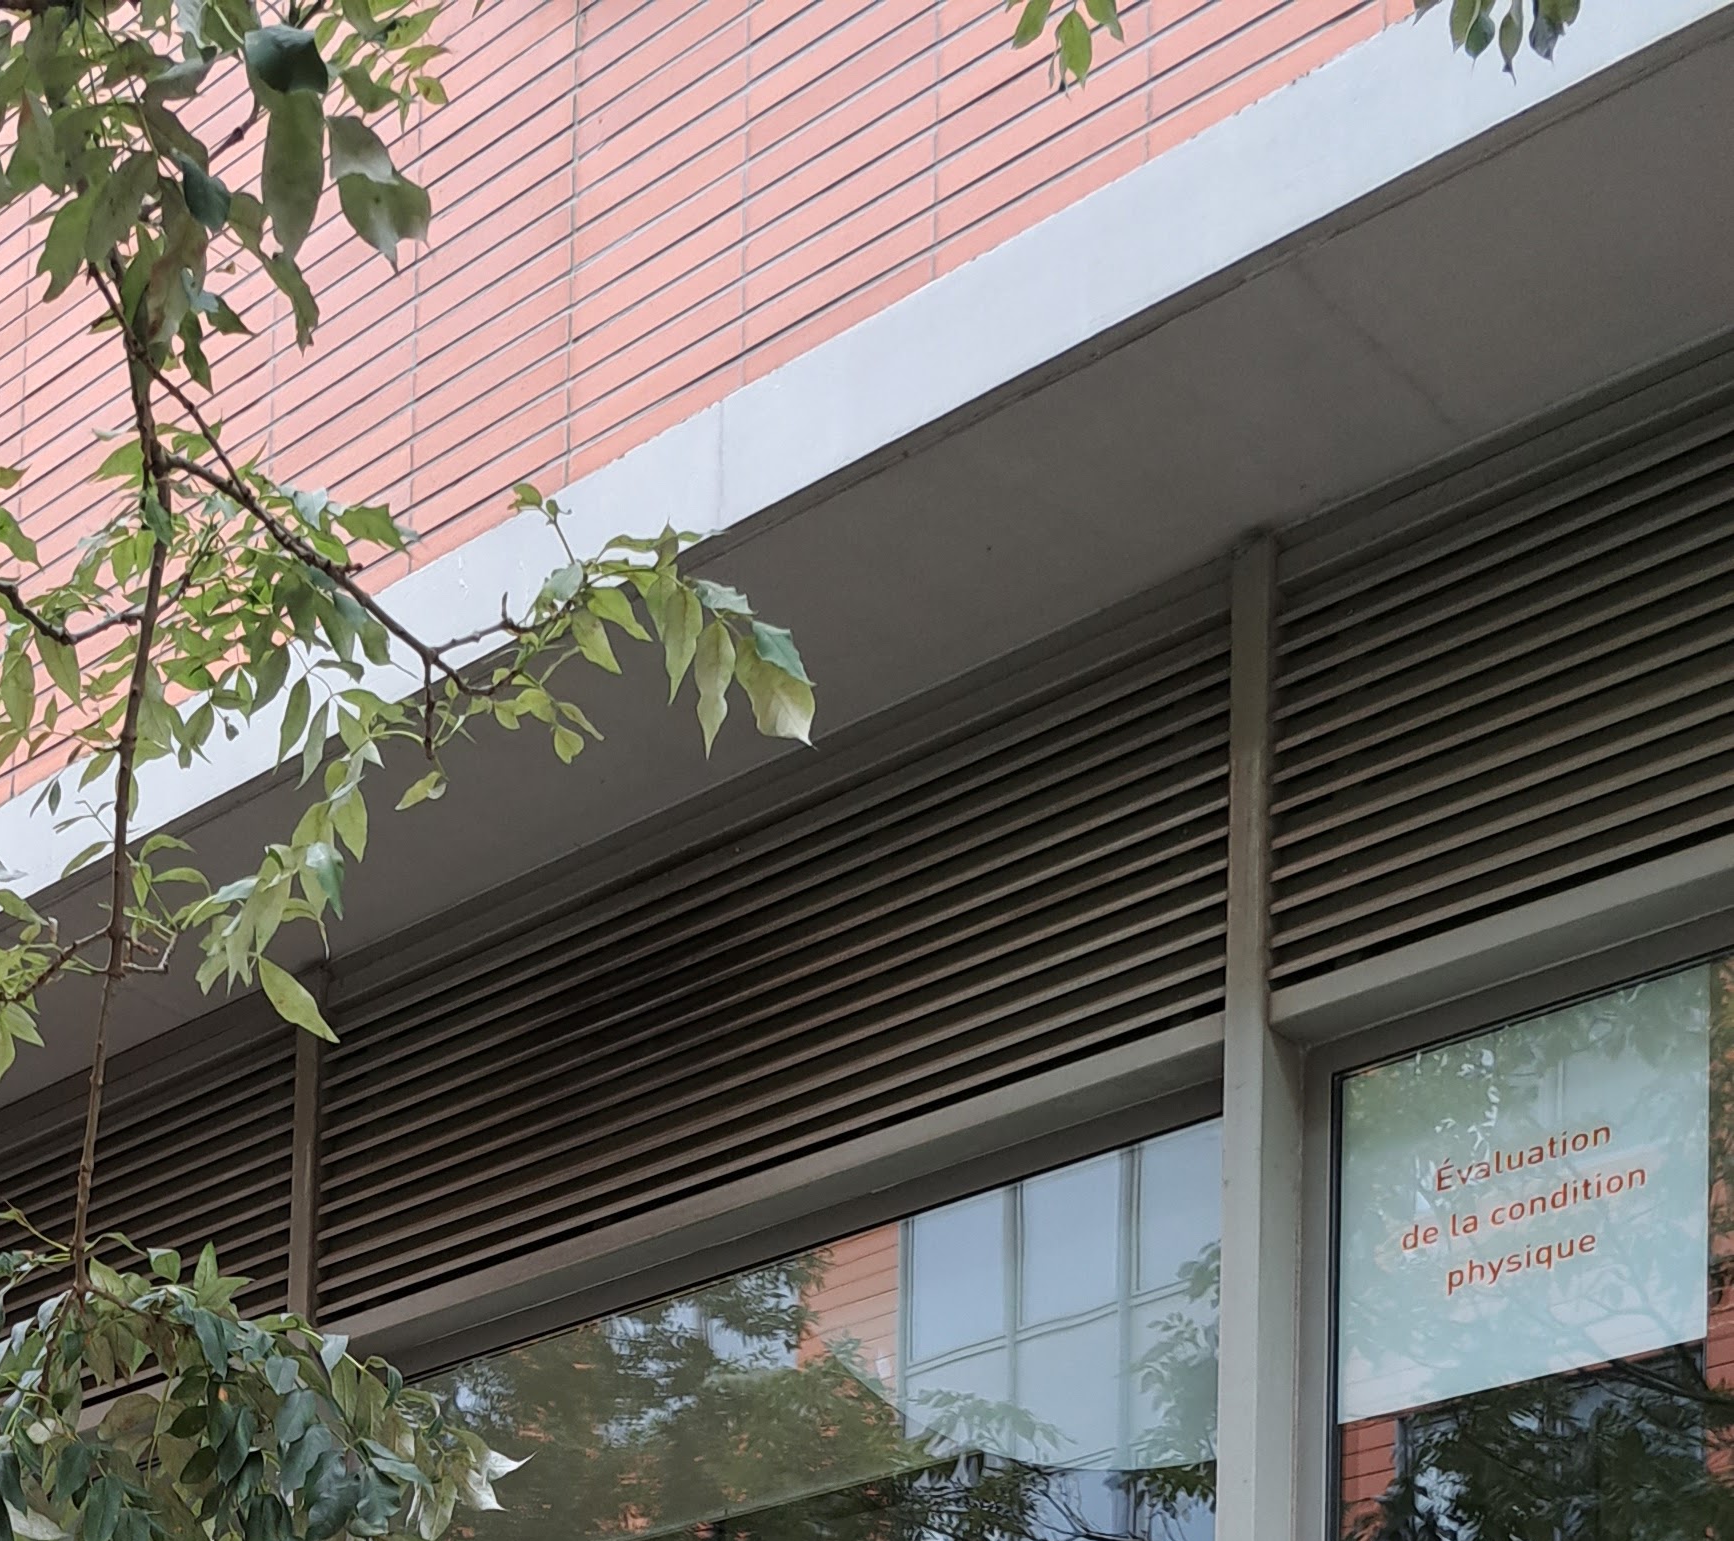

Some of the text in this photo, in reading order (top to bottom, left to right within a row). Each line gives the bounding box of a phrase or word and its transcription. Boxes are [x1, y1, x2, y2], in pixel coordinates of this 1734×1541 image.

[1436, 1124, 1611, 1192] Évaluation
[1401, 1165, 1647, 1252] de la condition
[1446, 1233, 1597, 1295] physique
